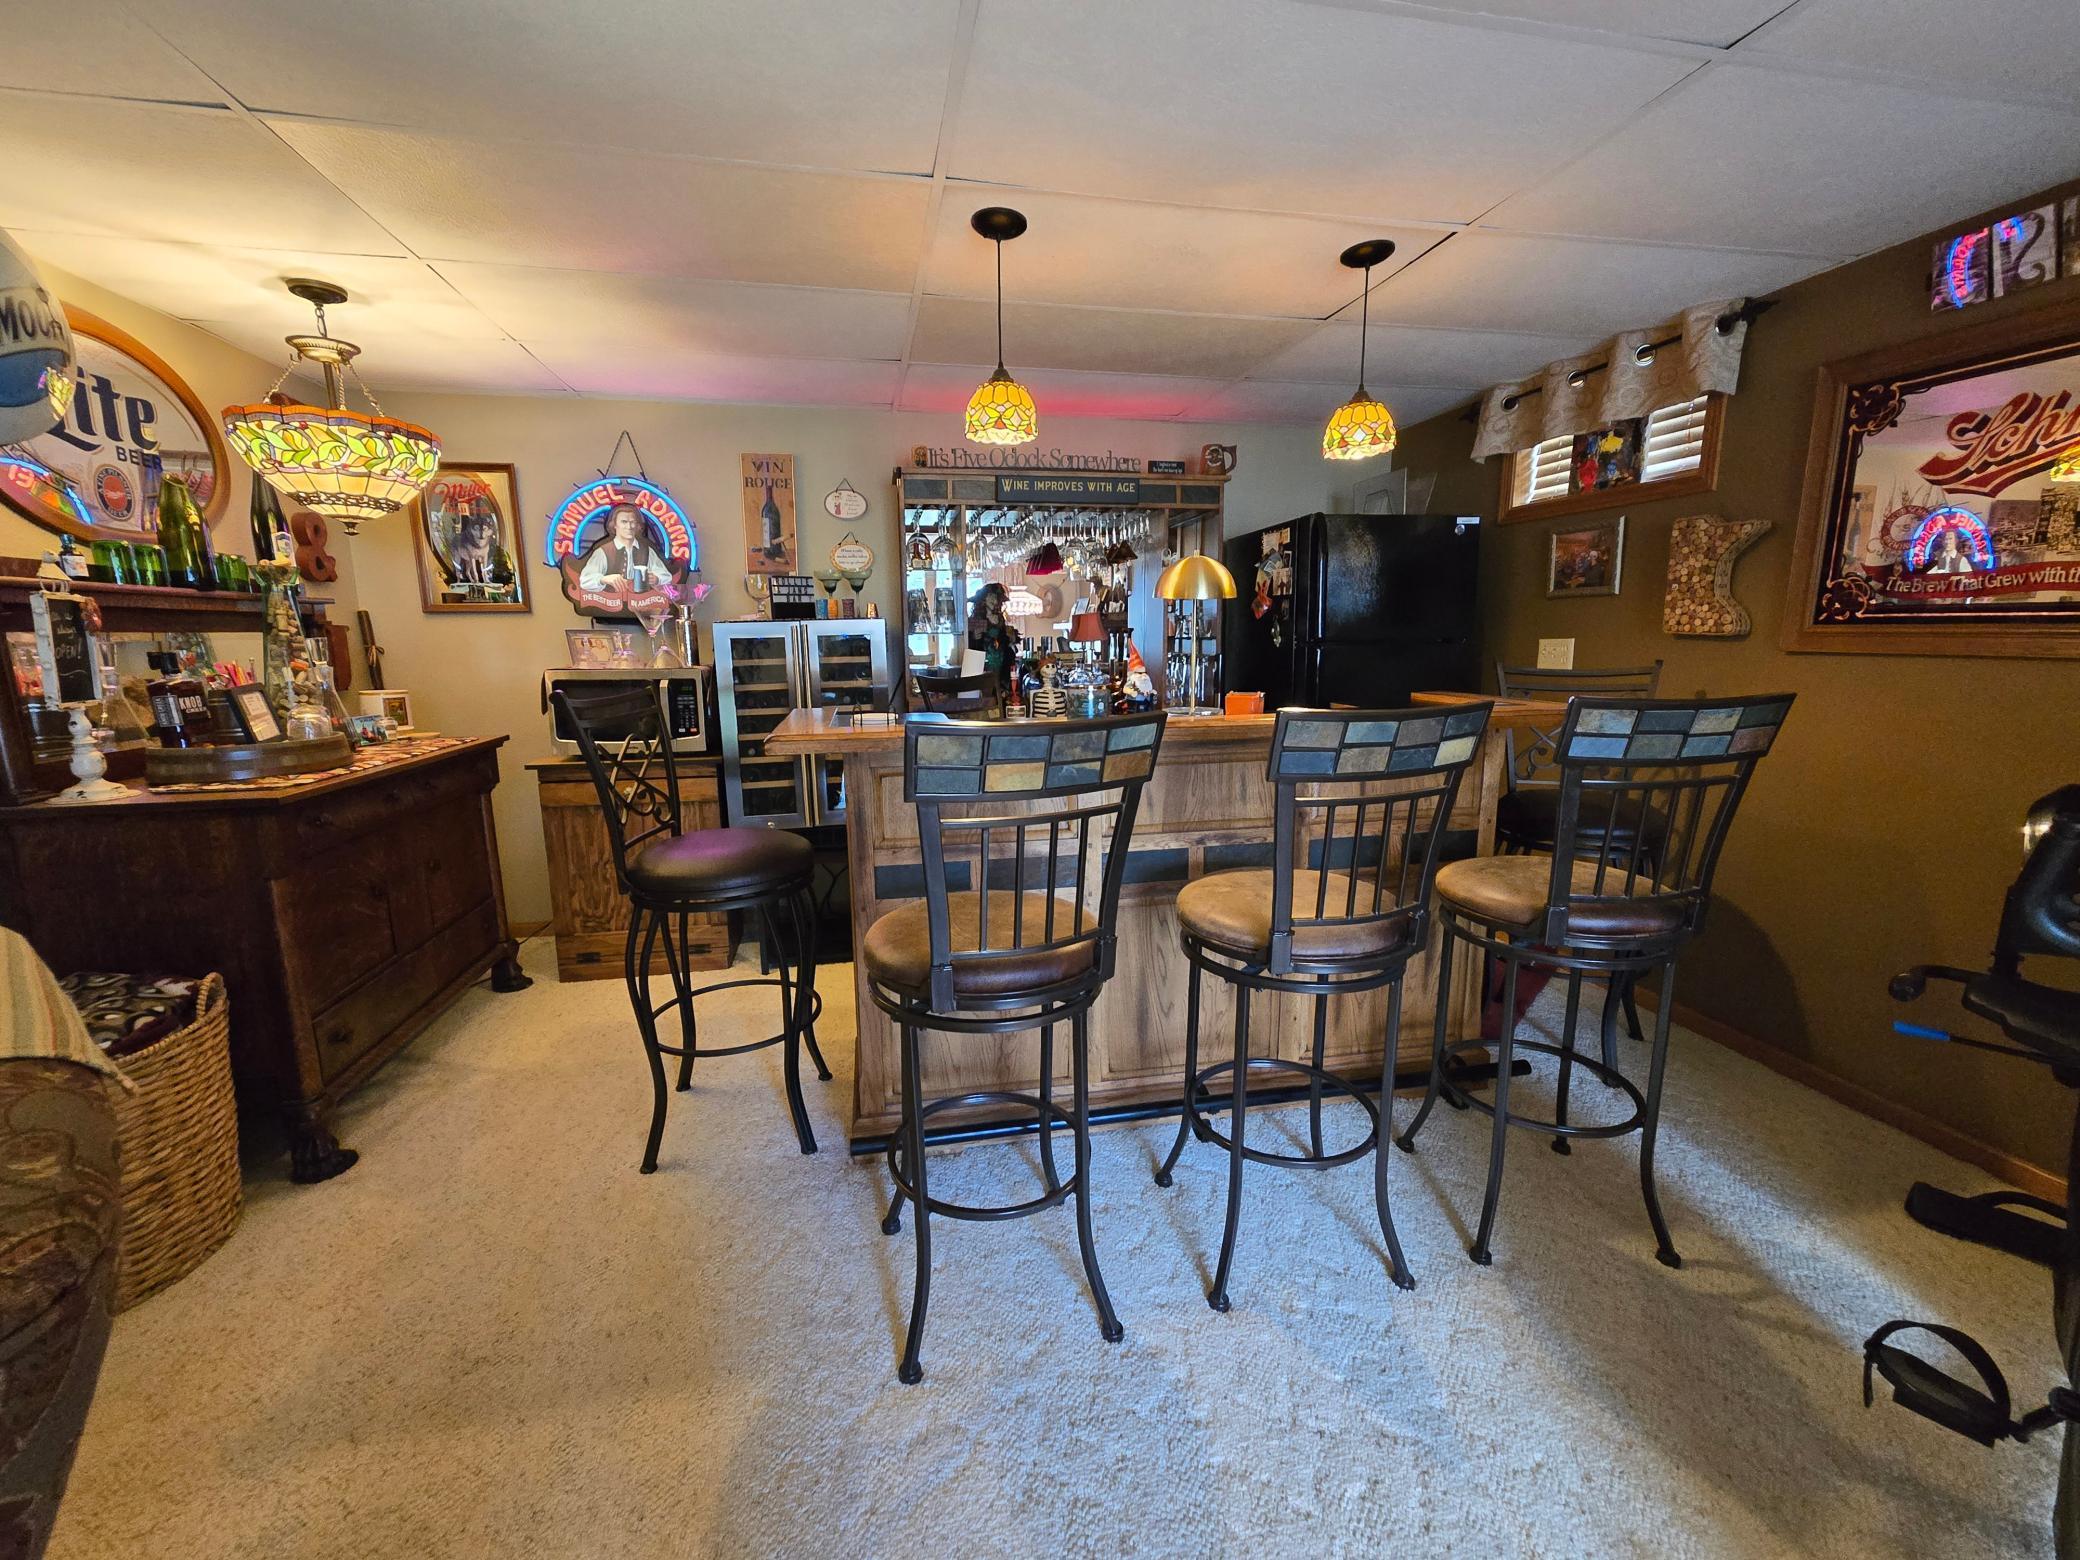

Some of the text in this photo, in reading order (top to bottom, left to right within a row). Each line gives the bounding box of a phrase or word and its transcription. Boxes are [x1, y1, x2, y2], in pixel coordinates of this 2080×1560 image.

[47, 366, 160, 452] ite
[116, 445, 163, 473] BEER
[751, 461, 784, 473] VIN
[928, 448, 949, 467] It's
[952, 447, 987, 468] Five
[1050, 448, 1141, 472] Somewhere
[430, 481, 491, 505] Miller
[744, 476, 792, 489] ROUGE
[1034, 481, 1084, 492] IMPROVES
[1087, 482, 1113, 492] WITH
[1116, 483, 1136, 492] AGE
[554, 483, 690, 560] SAMUEL ADAMS
[1886, 575, 1911, 592] The
[1911, 578, 1948, 593] Brew
[1949, 575, 1984, 592] That
[1984, 572, 2026, 588] Grew
[2028, 566, 2066, 583] with
[582, 593, 593, 601] THE
[179, 695, 203, 710] KNOB
